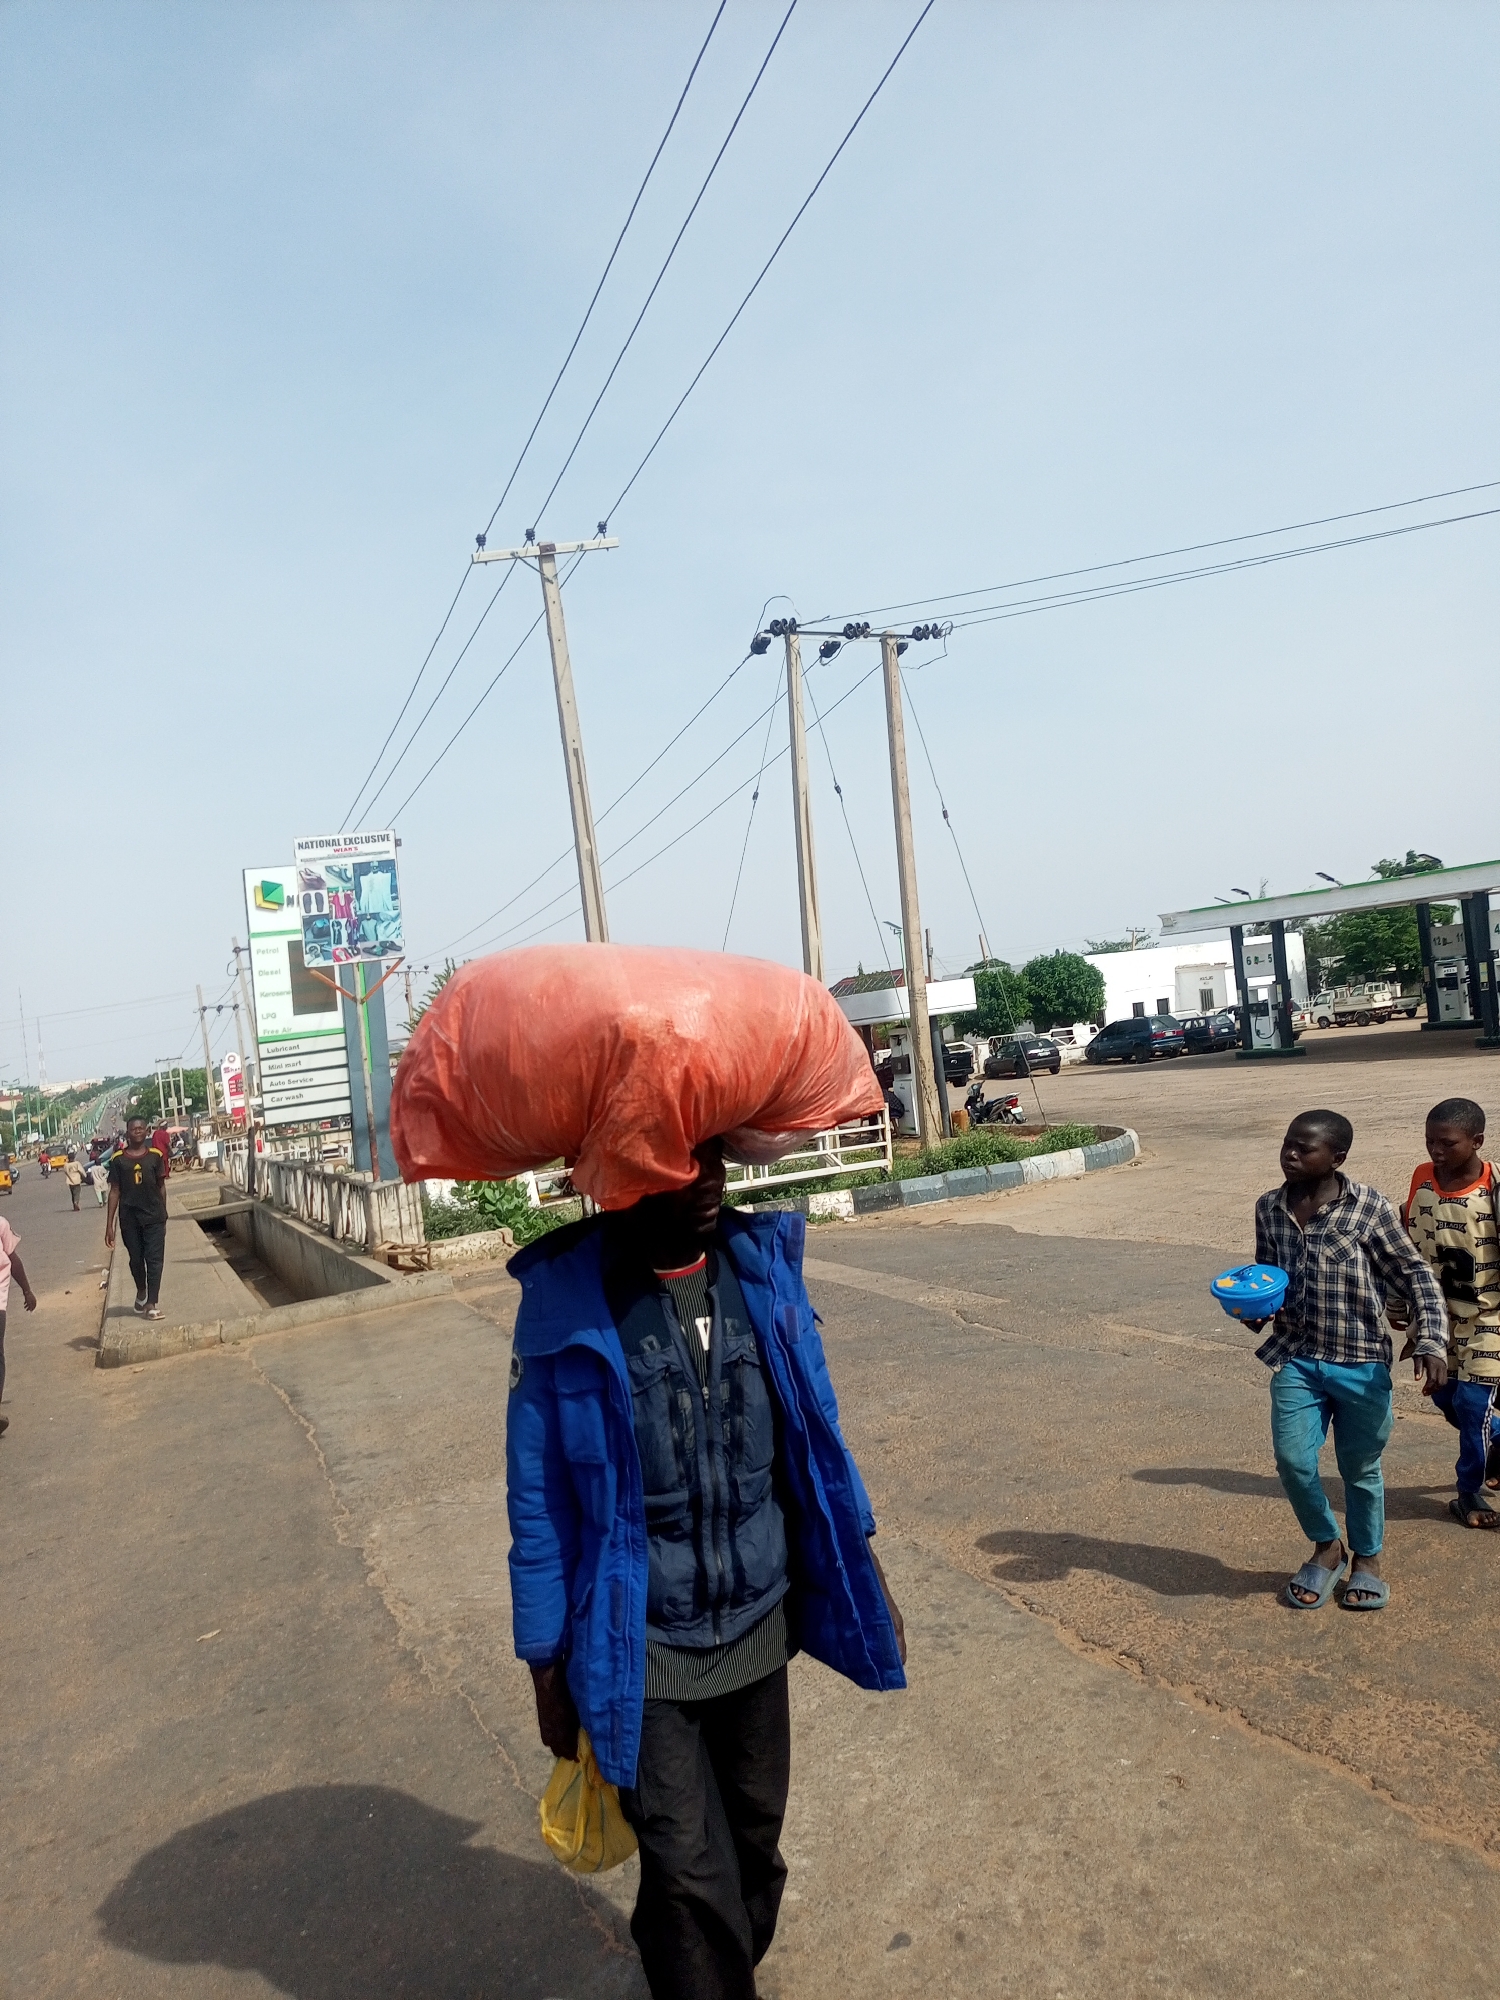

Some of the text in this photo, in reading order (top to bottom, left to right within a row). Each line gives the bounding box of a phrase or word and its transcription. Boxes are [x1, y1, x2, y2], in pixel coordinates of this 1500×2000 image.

[297, 833, 391, 850] NATIONAL EXCLUSIVE
[1433, 932, 1464, 946] 12 11
[256, 947, 279, 955] Petrol
[1246, 953, 1273, 965] 6 5
[258, 968, 281, 977] Diesel
[261, 1012, 277, 1020] LPG
[266, 1044, 300, 1054] Lubricant
[268, 1060, 302, 1071] Mini mart
[287, 1077, 314, 1085] Service
[284, 1093, 304, 1101] wash
[1435, 1244, 1480, 1306] 2
[695, 1316, 712, 1351] V
